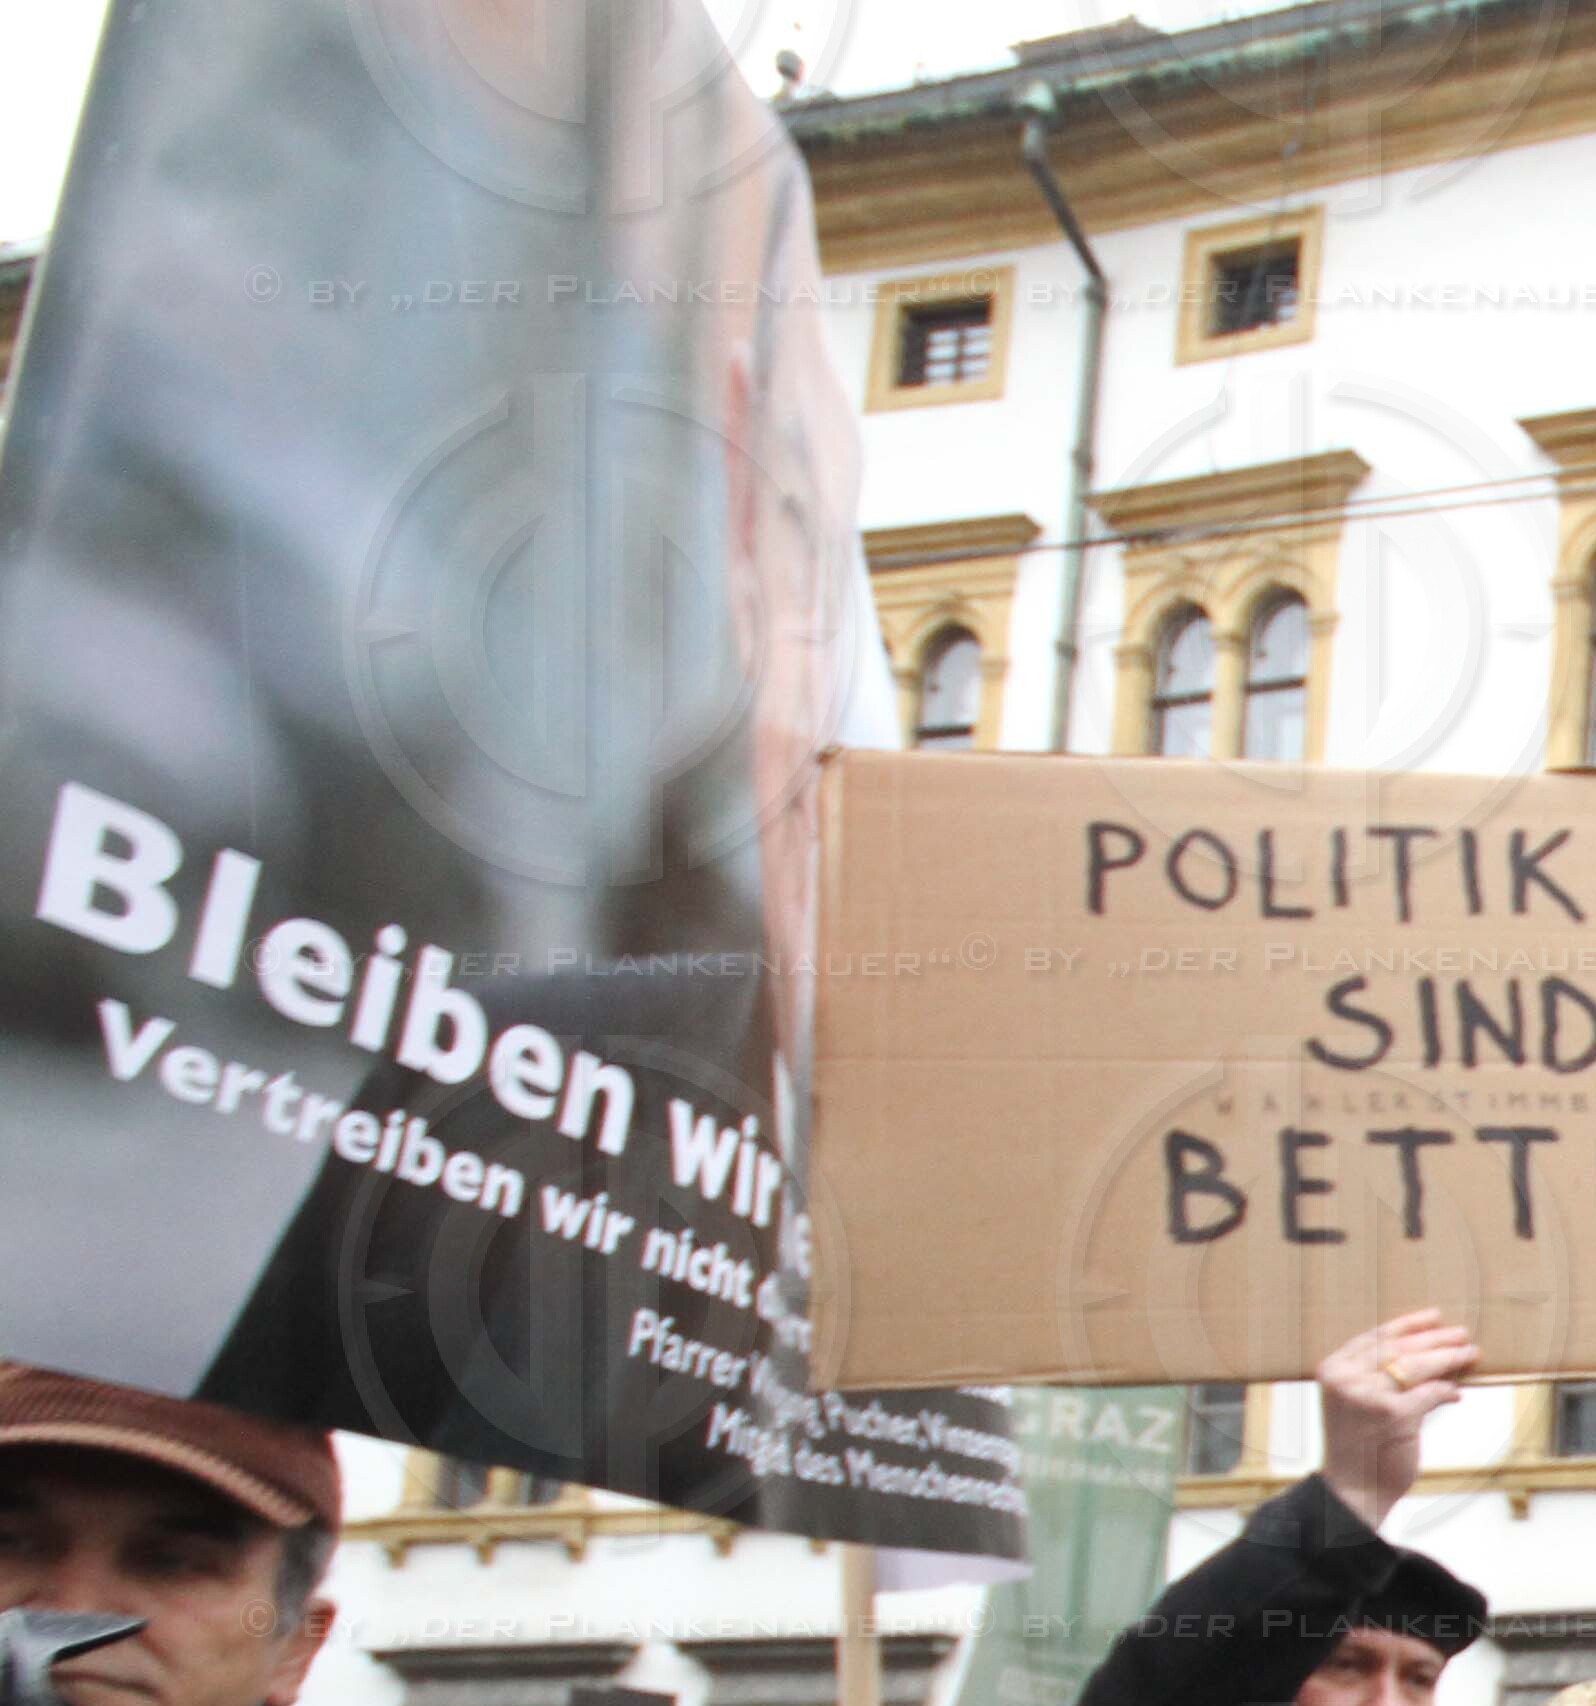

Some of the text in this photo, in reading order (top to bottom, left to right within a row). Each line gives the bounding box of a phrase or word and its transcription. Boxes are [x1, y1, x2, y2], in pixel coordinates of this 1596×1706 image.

[36, 780, 783, 1228] Bleiben wir
[98, 997, 525, 1218] Vertreiben
[541, 1183, 636, 1256] wir
[641, 1227, 754, 1309] nicht
[628, 1307, 748, 1389] Pfarrer
